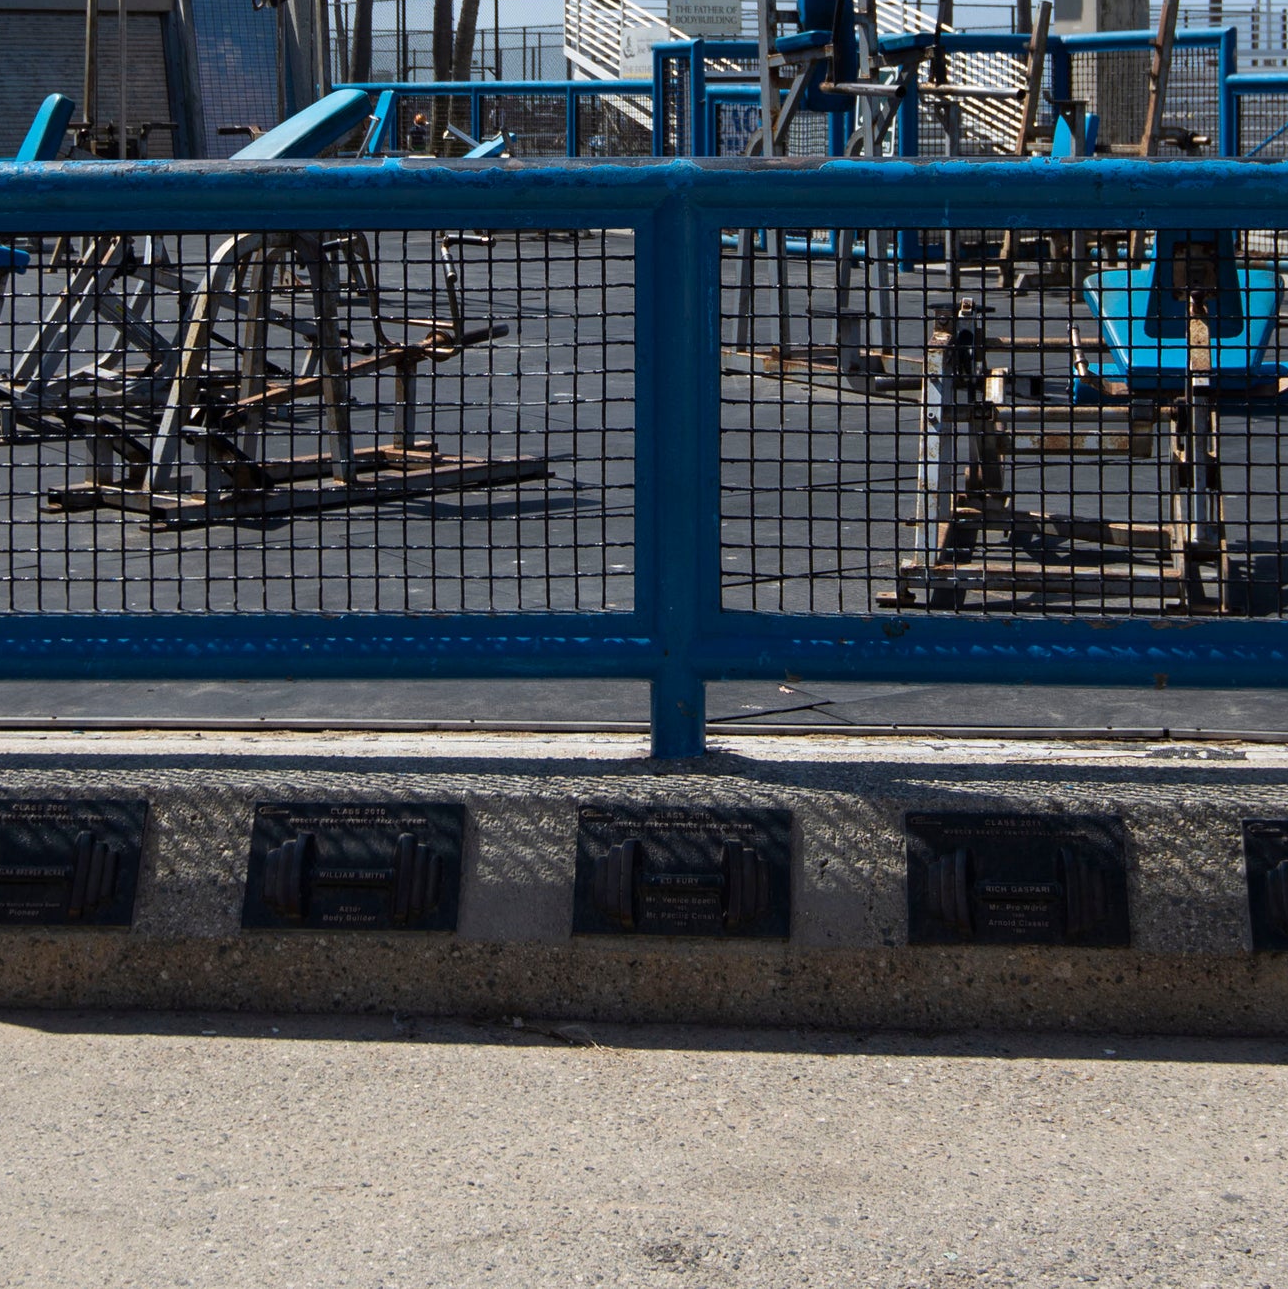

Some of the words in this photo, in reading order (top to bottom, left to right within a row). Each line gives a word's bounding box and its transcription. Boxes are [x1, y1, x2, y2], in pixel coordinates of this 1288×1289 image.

[675, 5, 692, 14] THE
[693, 5, 724, 14] FATHER
[726, 6, 738, 14] OF
[675, 15, 737, 24] BODYBUILDING
[984, 819, 1016, 827] CLASS
[319, 871, 355, 879] WILLIAM
[359, 871, 386, 879] SMITH
[676, 877, 699, 885] FURY
[985, 885, 1007, 893] RICH
[1011, 885, 1050, 893] GASPARI
[663, 896, 689, 904] Venice
[322, 915, 343, 923] Body
[346, 914, 377, 922] Builder
[988, 919, 1016, 927] Arnold
[1018, 919, 1049, 927] Classic
